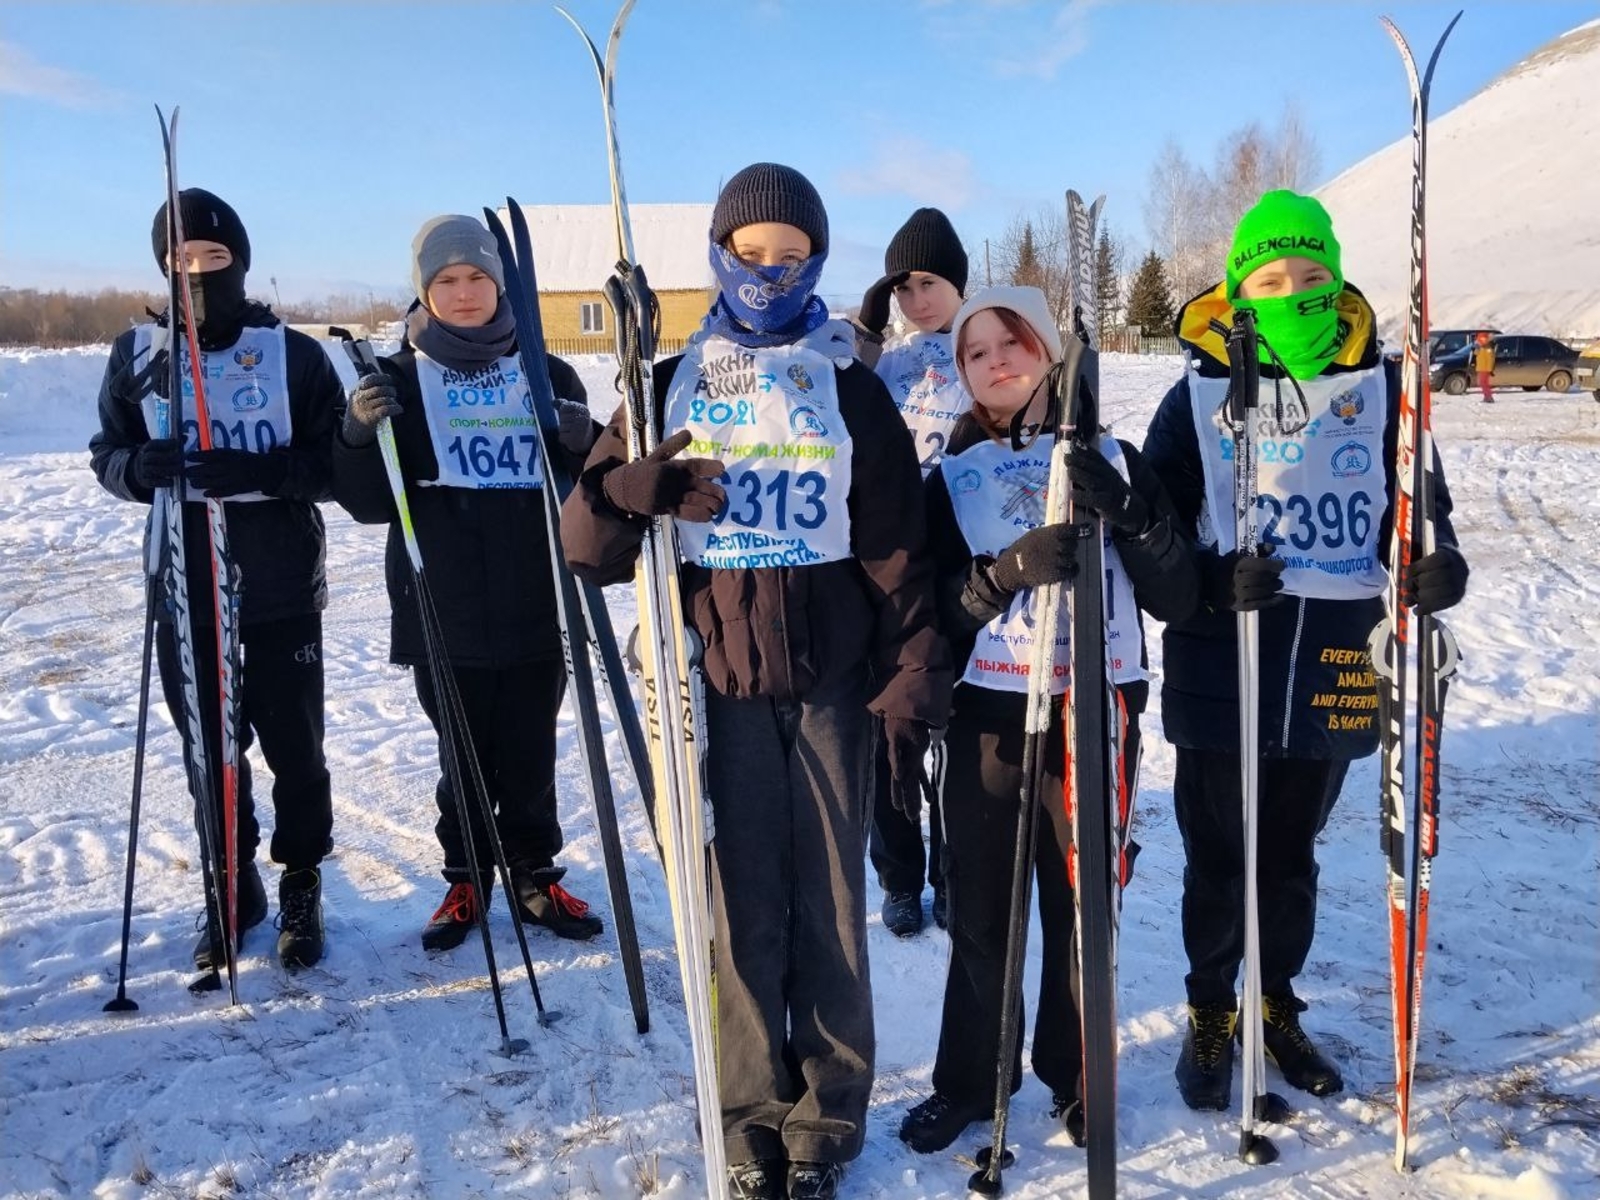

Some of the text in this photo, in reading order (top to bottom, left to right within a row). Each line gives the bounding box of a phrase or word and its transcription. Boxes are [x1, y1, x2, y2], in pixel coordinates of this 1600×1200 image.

[1073, 202, 1097, 331] MADSHUS
[1234, 235, 1326, 271] BALENCIAGA
[446, 388, 506, 408] 2021
[688, 400, 757, 426] 2021
[449, 418, 481, 428] СПОРТ
[448, 434, 538, 478] 1647
[781, 444, 836, 459] ЖИЗНИ
[1219, 438, 1304, 464] 220
[1256, 490, 1372, 551] 2396
[560, 630, 574, 677] TISA
[590, 638, 609, 685] TISA
[644, 677, 662, 744] TISA
[679, 676, 695, 744] TISA
[1311, 693, 1337, 707] AND
[1328, 714, 1372, 730] IS HAPPY
